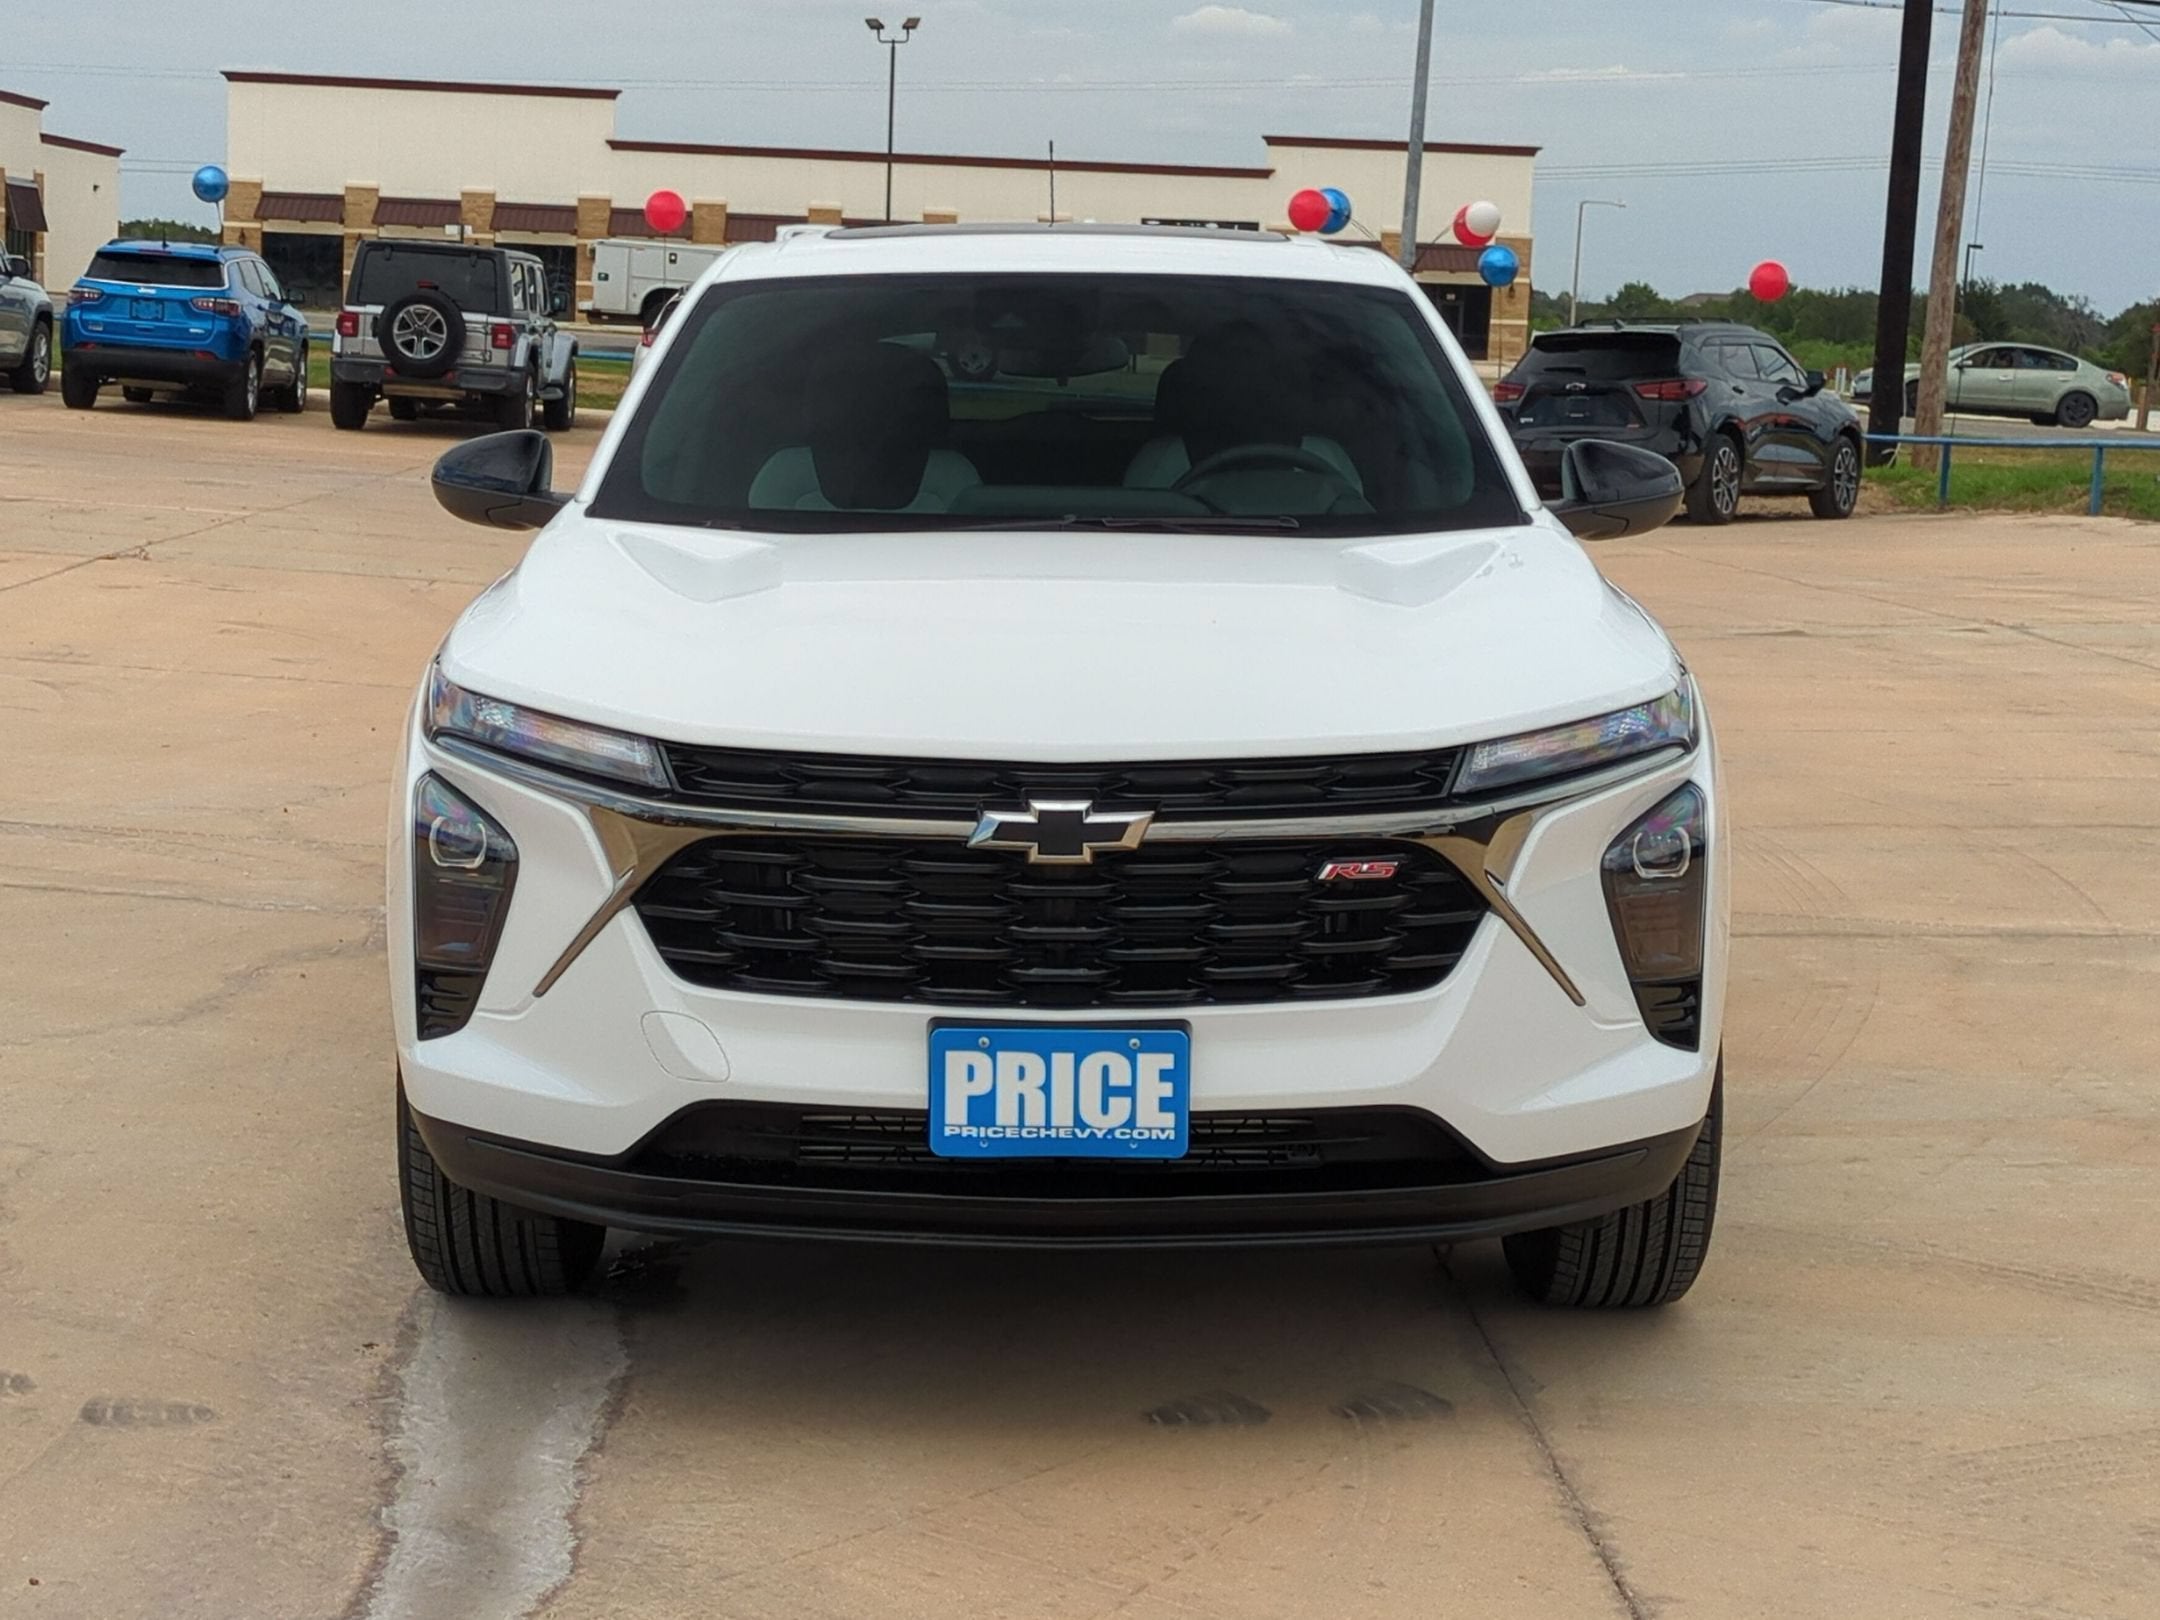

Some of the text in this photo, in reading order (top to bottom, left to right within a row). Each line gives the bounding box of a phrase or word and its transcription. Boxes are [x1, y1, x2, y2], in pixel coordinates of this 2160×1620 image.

[1318, 862, 1399, 880] RS
[944, 1050, 1176, 1129] PRICE
[943, 1126, 1176, 1140] PRICECHEVY.COM
